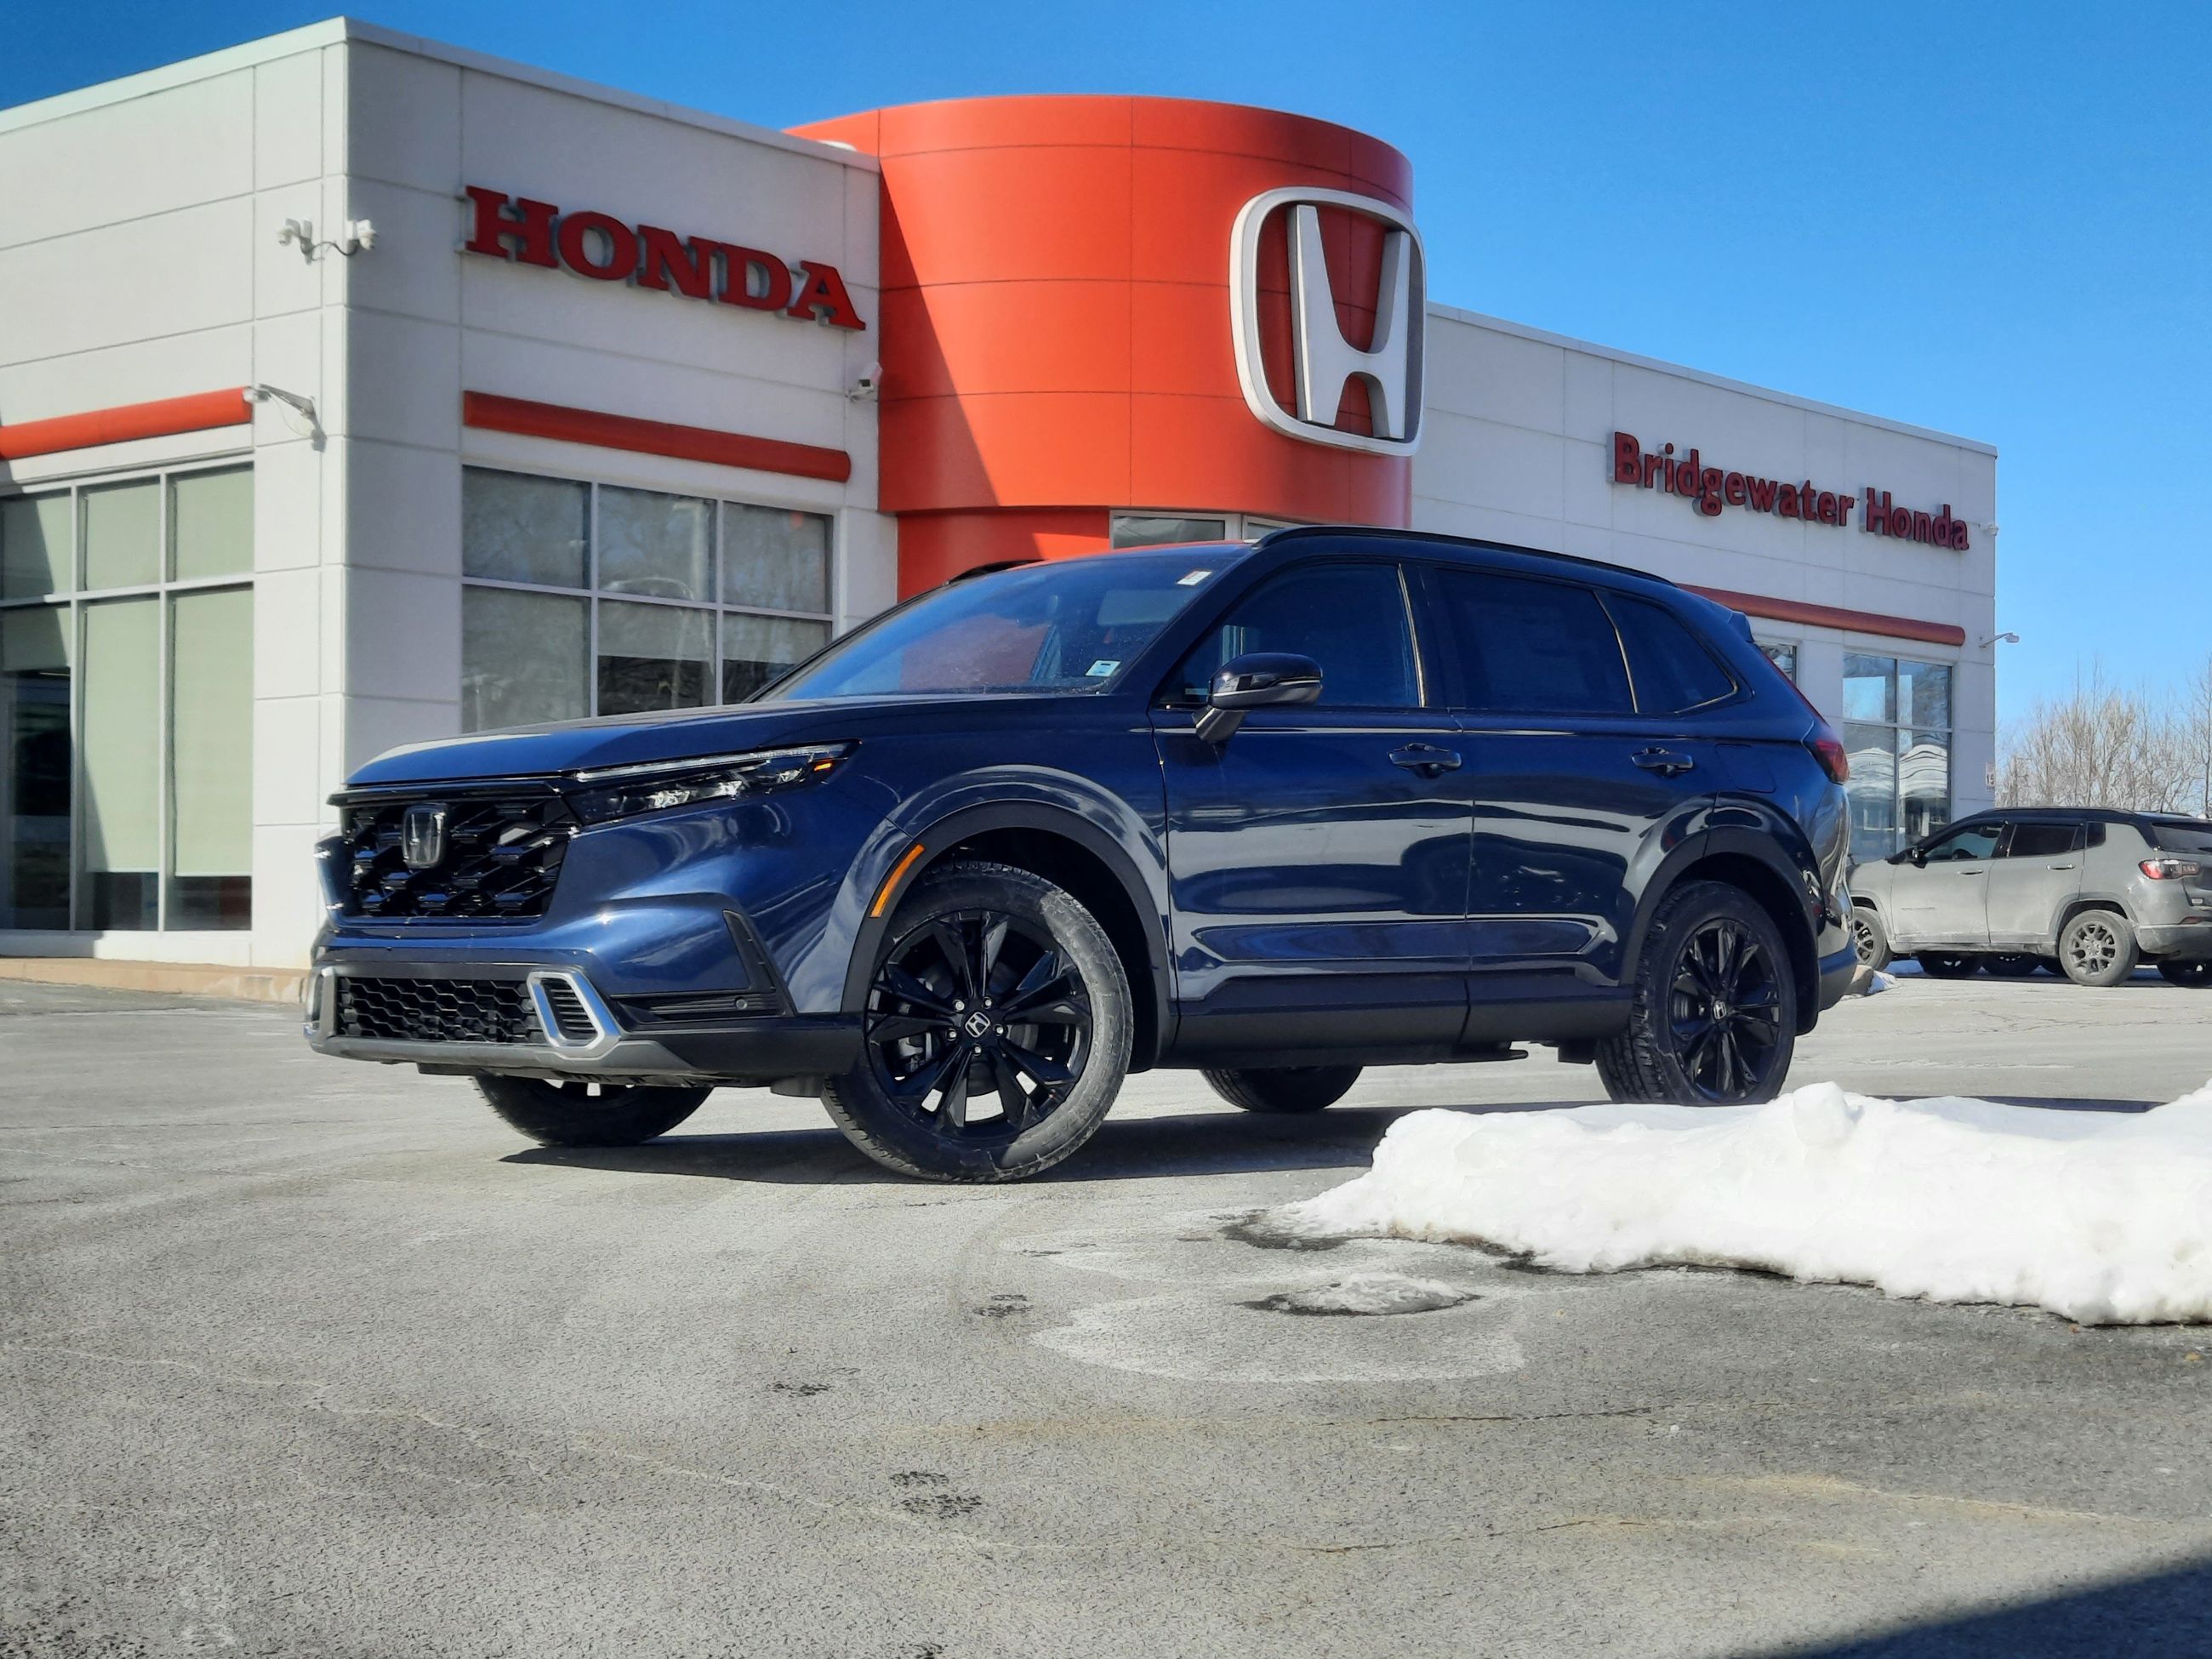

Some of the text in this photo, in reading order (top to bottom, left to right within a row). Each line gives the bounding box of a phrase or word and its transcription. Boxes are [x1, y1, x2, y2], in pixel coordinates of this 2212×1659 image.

[465, 185, 866, 331] HONDA
[1286, 203, 1411, 440] H
[1613, 431, 1970, 551] Bridgewater Honda
